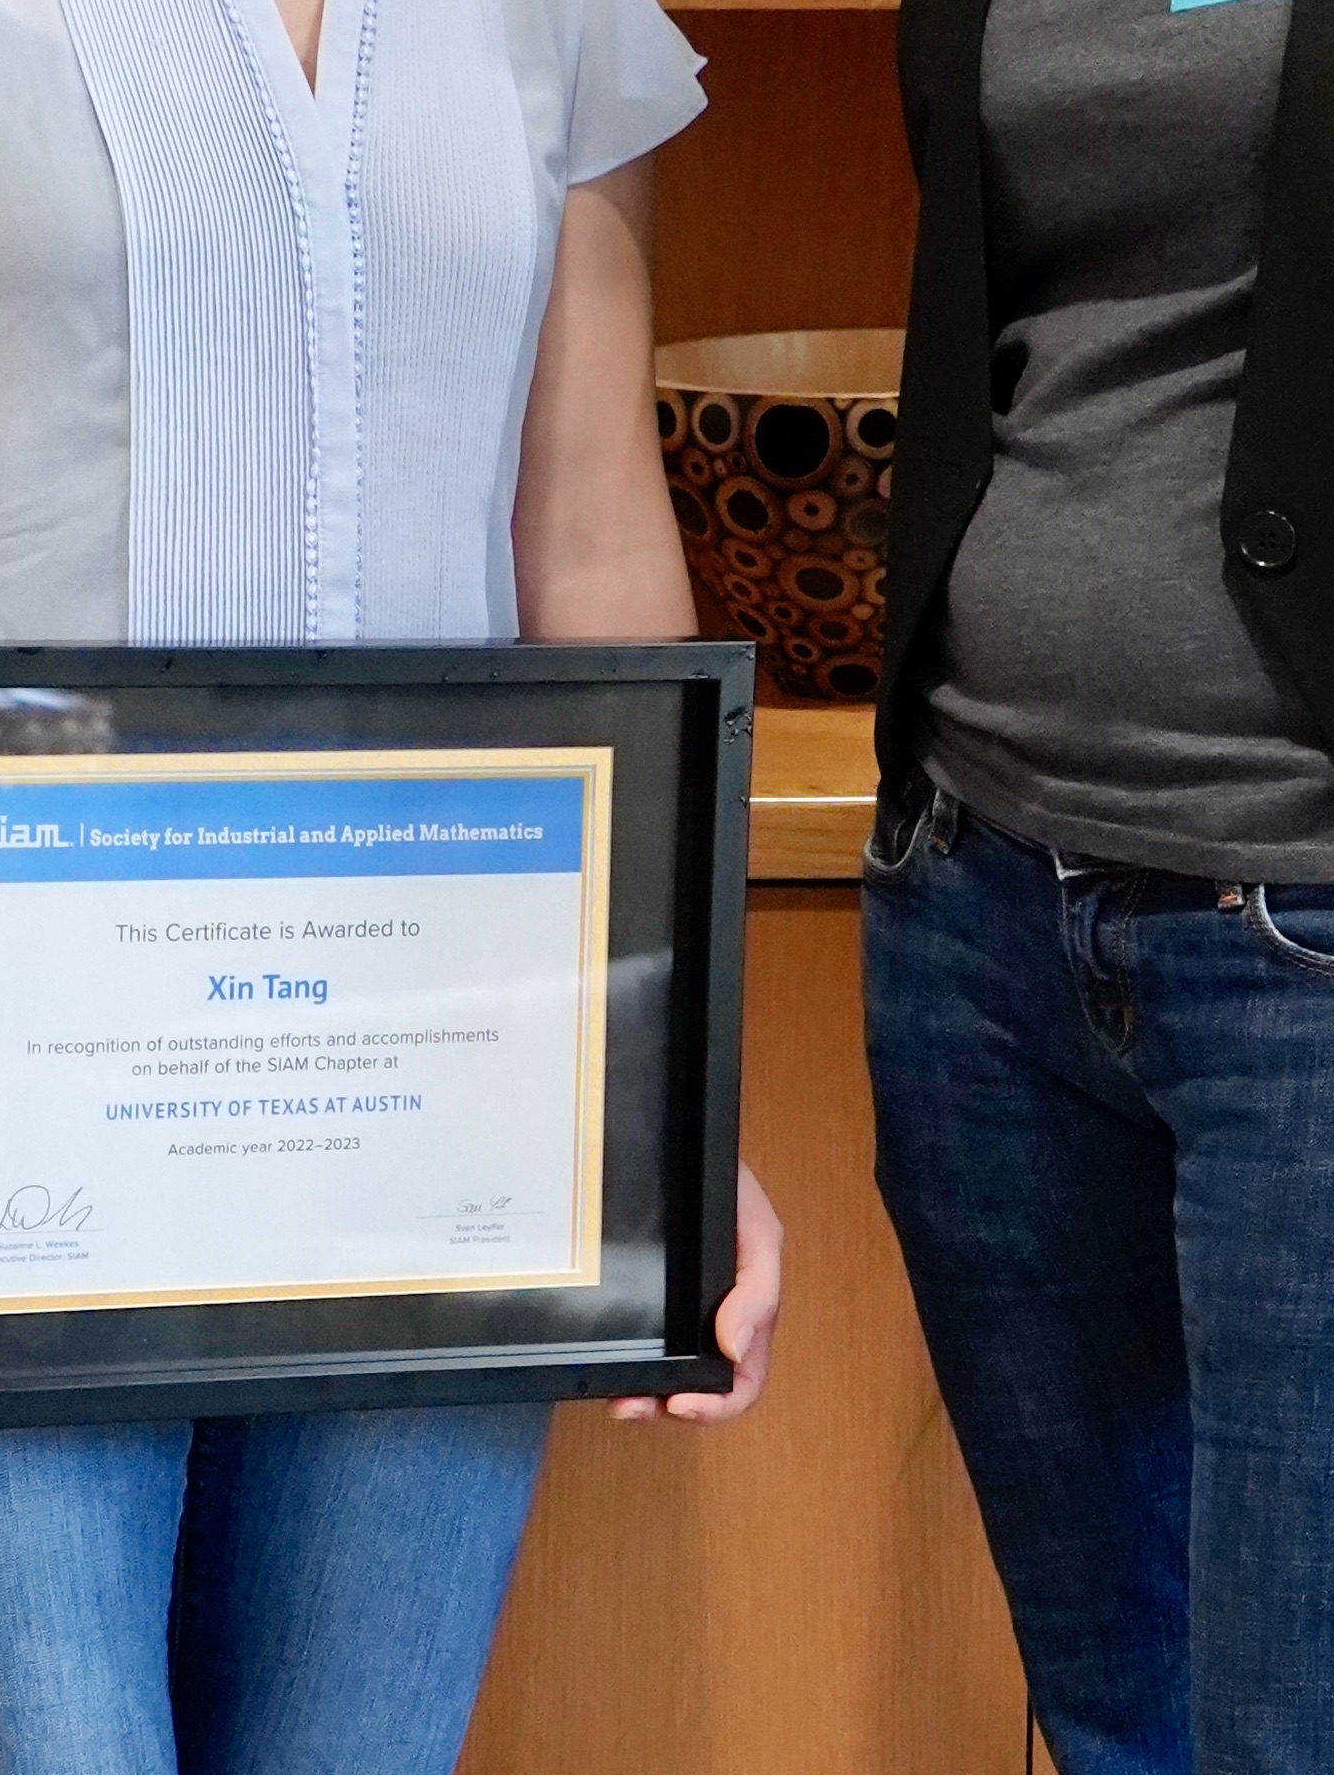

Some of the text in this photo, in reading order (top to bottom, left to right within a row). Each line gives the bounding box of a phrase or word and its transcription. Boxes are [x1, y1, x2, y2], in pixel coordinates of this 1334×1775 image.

[90, 823, 543, 850] Society for Industrial and Applied Mathematics
[116, 919, 420, 942] This Certificate is Awarded to
[208, 974, 327, 1004] Xin Tang
[28, 1029, 499, 1057] In recognition of outstanding efforts and accomplishments
[132, 1056, 398, 1076] on behalf of the SIAM Chapter at
[107, 1095, 421, 1120] UNIVERSITY OF TEXAS AT AUSTIN
[168, 1143, 236, 1155] Academic
[242, 1143, 272, 1156] year
[67, 1252, 89, 1260] SIAM
